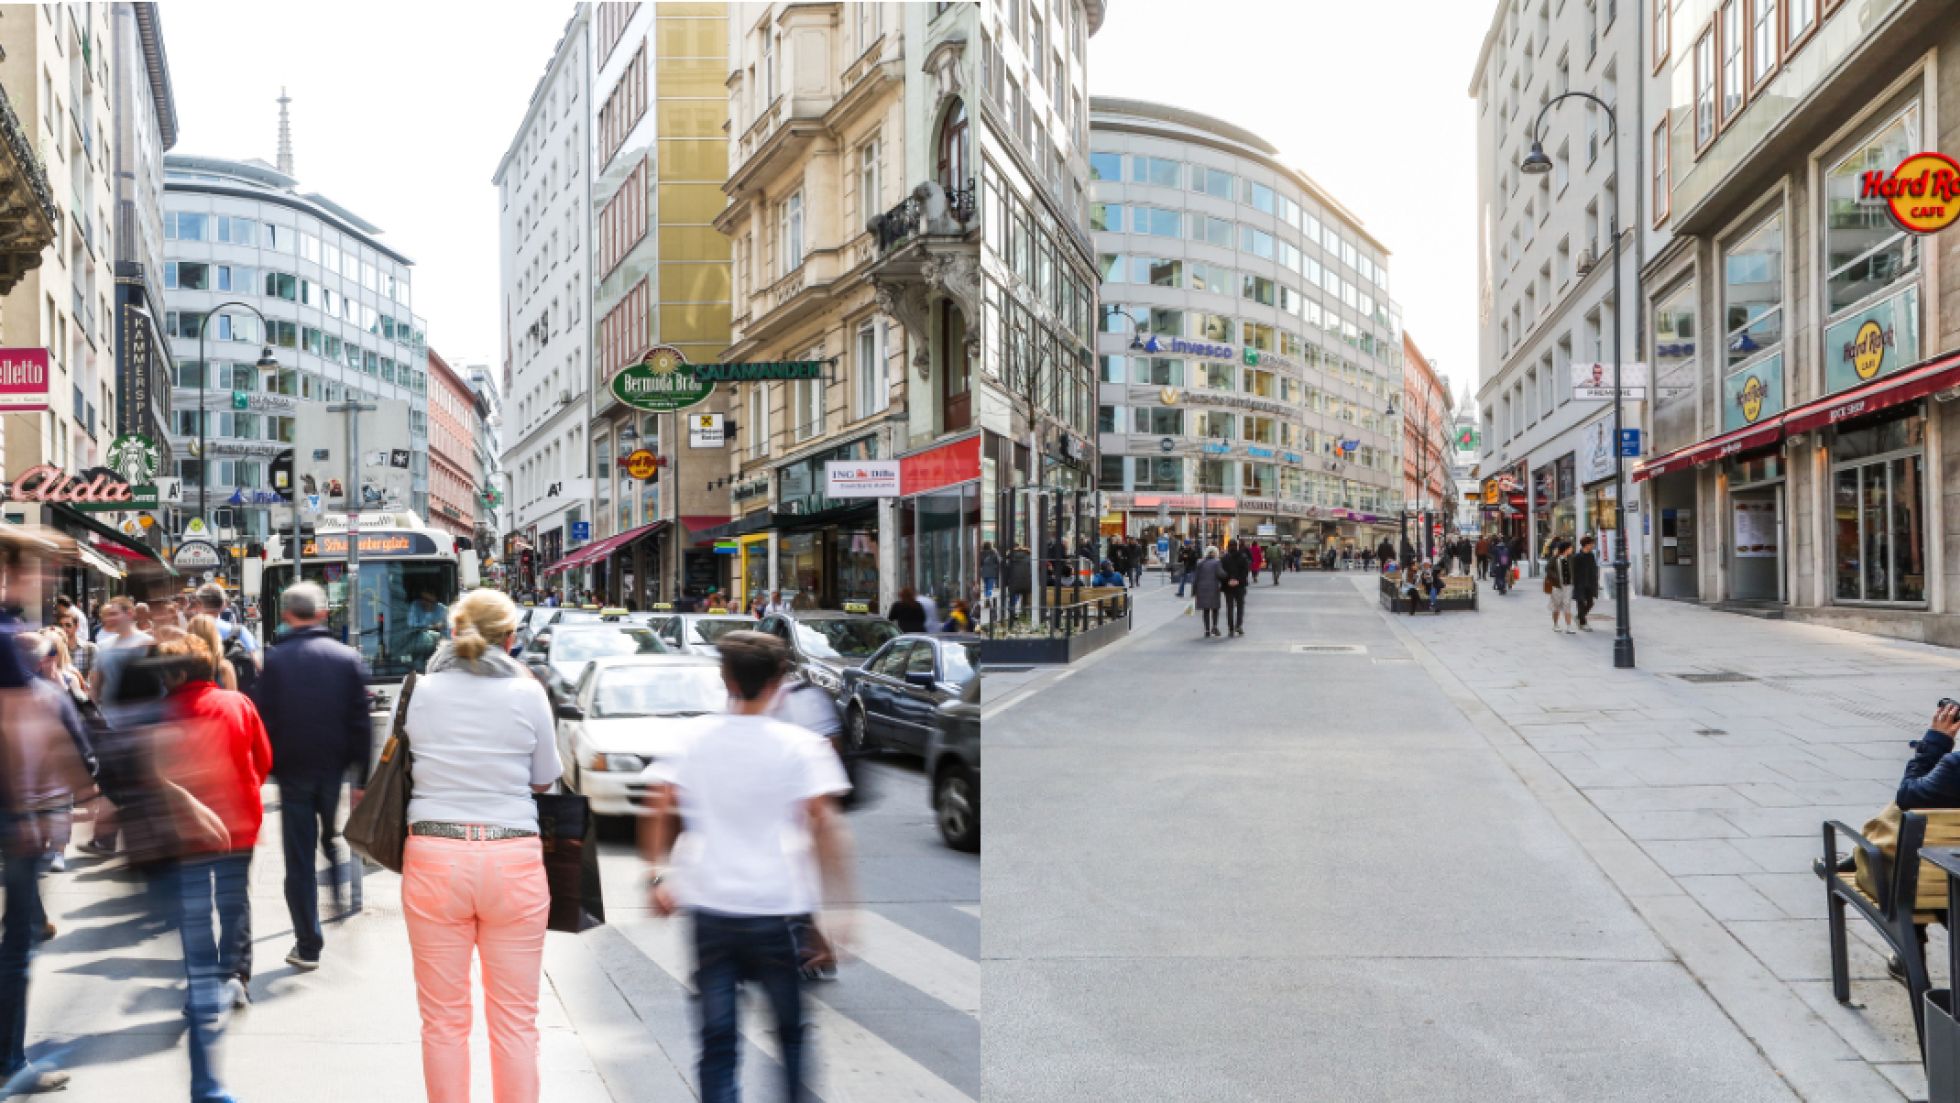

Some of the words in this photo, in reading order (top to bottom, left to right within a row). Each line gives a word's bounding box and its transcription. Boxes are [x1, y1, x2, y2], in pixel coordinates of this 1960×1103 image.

[1861, 169, 1930, 199] Hard
[1911, 206, 1945, 218] CAFE
[1843, 333, 1868, 363] Hard
[1870, 323, 1894, 354] Rock
[695, 362, 819, 380] SALAMANDER
[624, 372, 673, 393] Bermuda
[832, 470, 854, 479] ING
